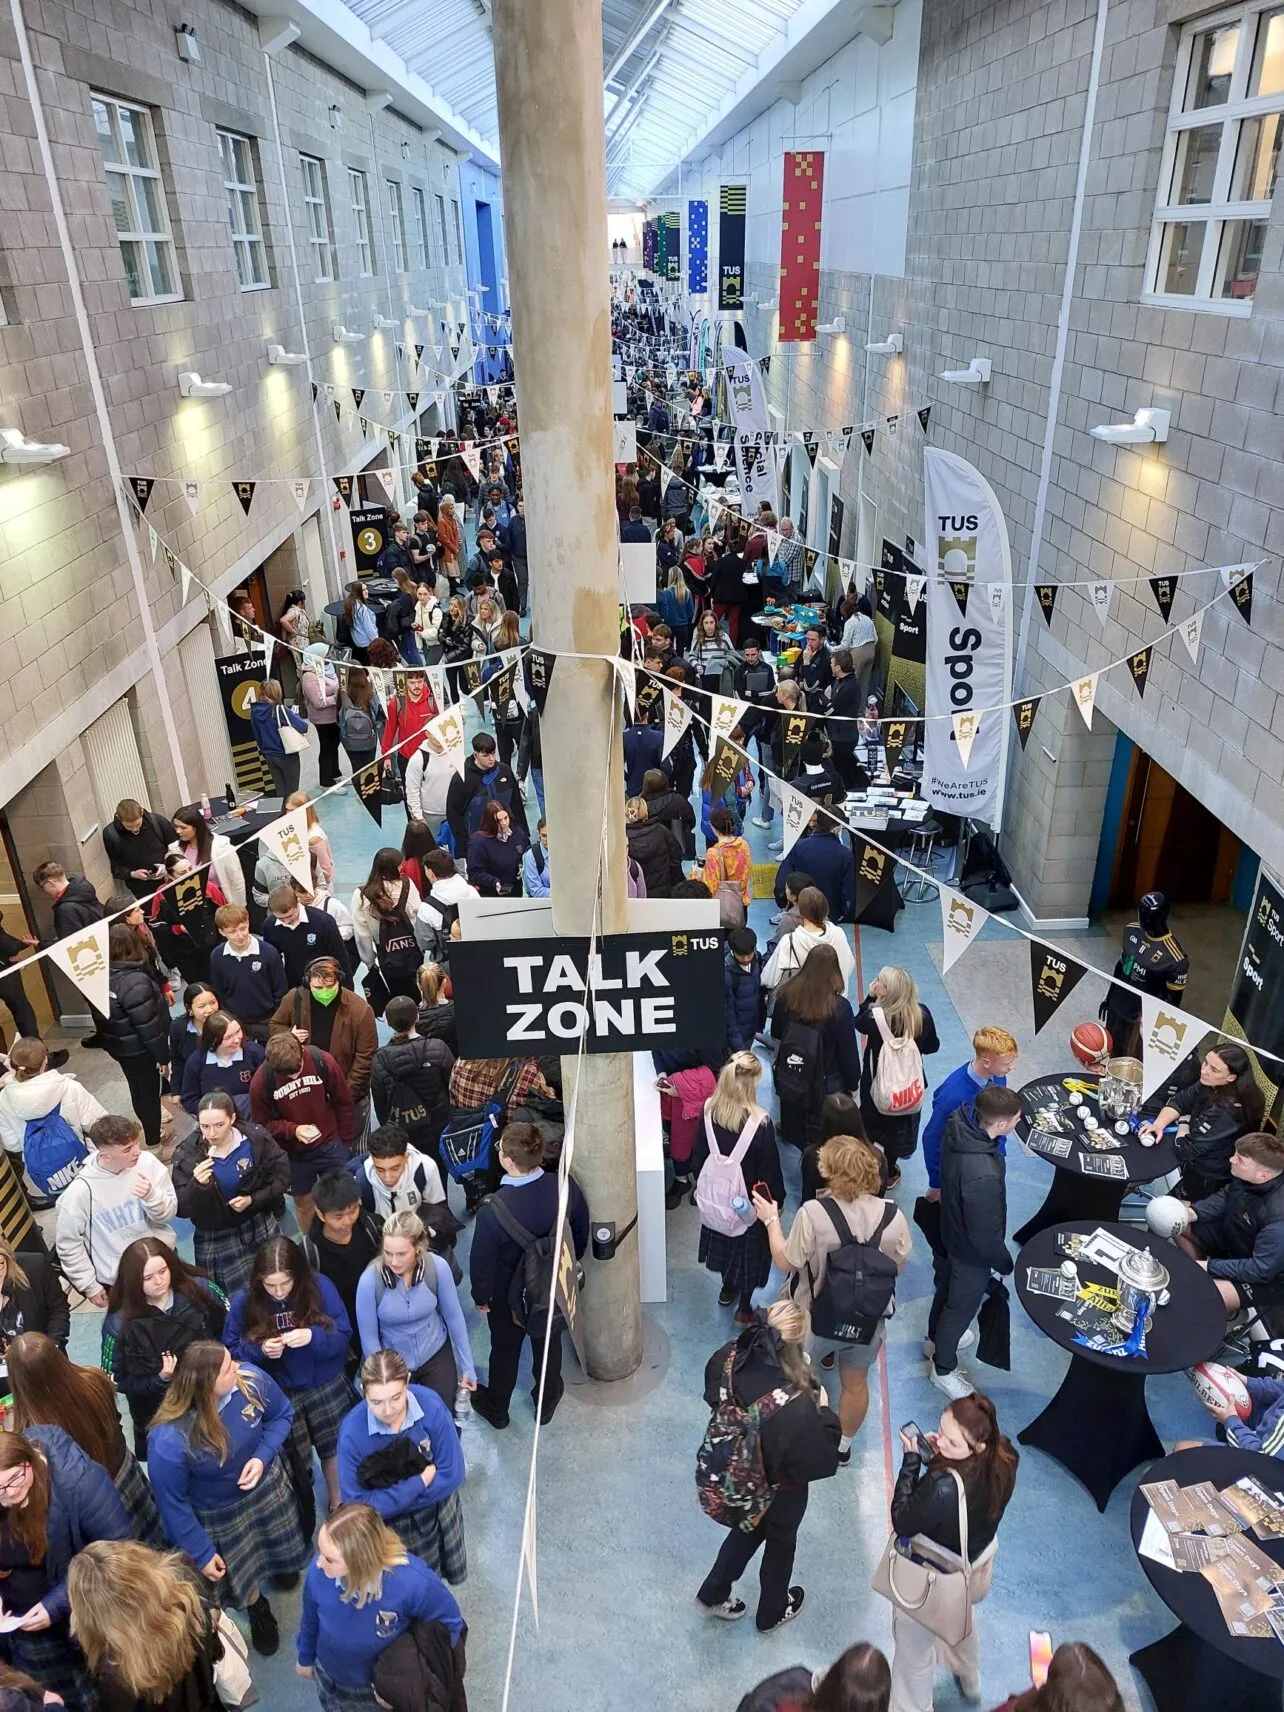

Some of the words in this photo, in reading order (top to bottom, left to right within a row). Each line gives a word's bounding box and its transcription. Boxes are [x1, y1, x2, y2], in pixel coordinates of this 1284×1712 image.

[723, 266, 741, 275] TUS
[732, 374, 751, 384] TUS
[352, 515, 366, 523] Talk
[366, 513, 384, 521] Zone
[938, 515, 979, 532] TUS
[363, 532, 376, 550] 3
[900, 622, 919, 635] Sport
[531, 653, 545, 664] TUS
[220, 662, 243, 676] Talk
[648, 679, 662, 689] TUS
[1021, 702, 1033, 711] TUS
[931, 776, 989, 790] #WeAreTUS
[931, 788, 987, 800] www.tus.ie
[791, 795, 804, 809] TUS
[277, 824, 295, 839] TUS
[1267, 918, 1284, 947] Sport
[385, 935, 415, 953] VANS
[690, 937, 719, 950] TUS
[1046, 954, 1067, 973] TUS
[503, 949, 671, 994] TALK
[1243, 956, 1264, 991] Sport
[506, 996, 677, 1041] ZONE
[892, 1078, 924, 1108] NIKE
[402, 1104, 427, 1124] TUS
[1188, 1373, 1225, 1409] GILBER
